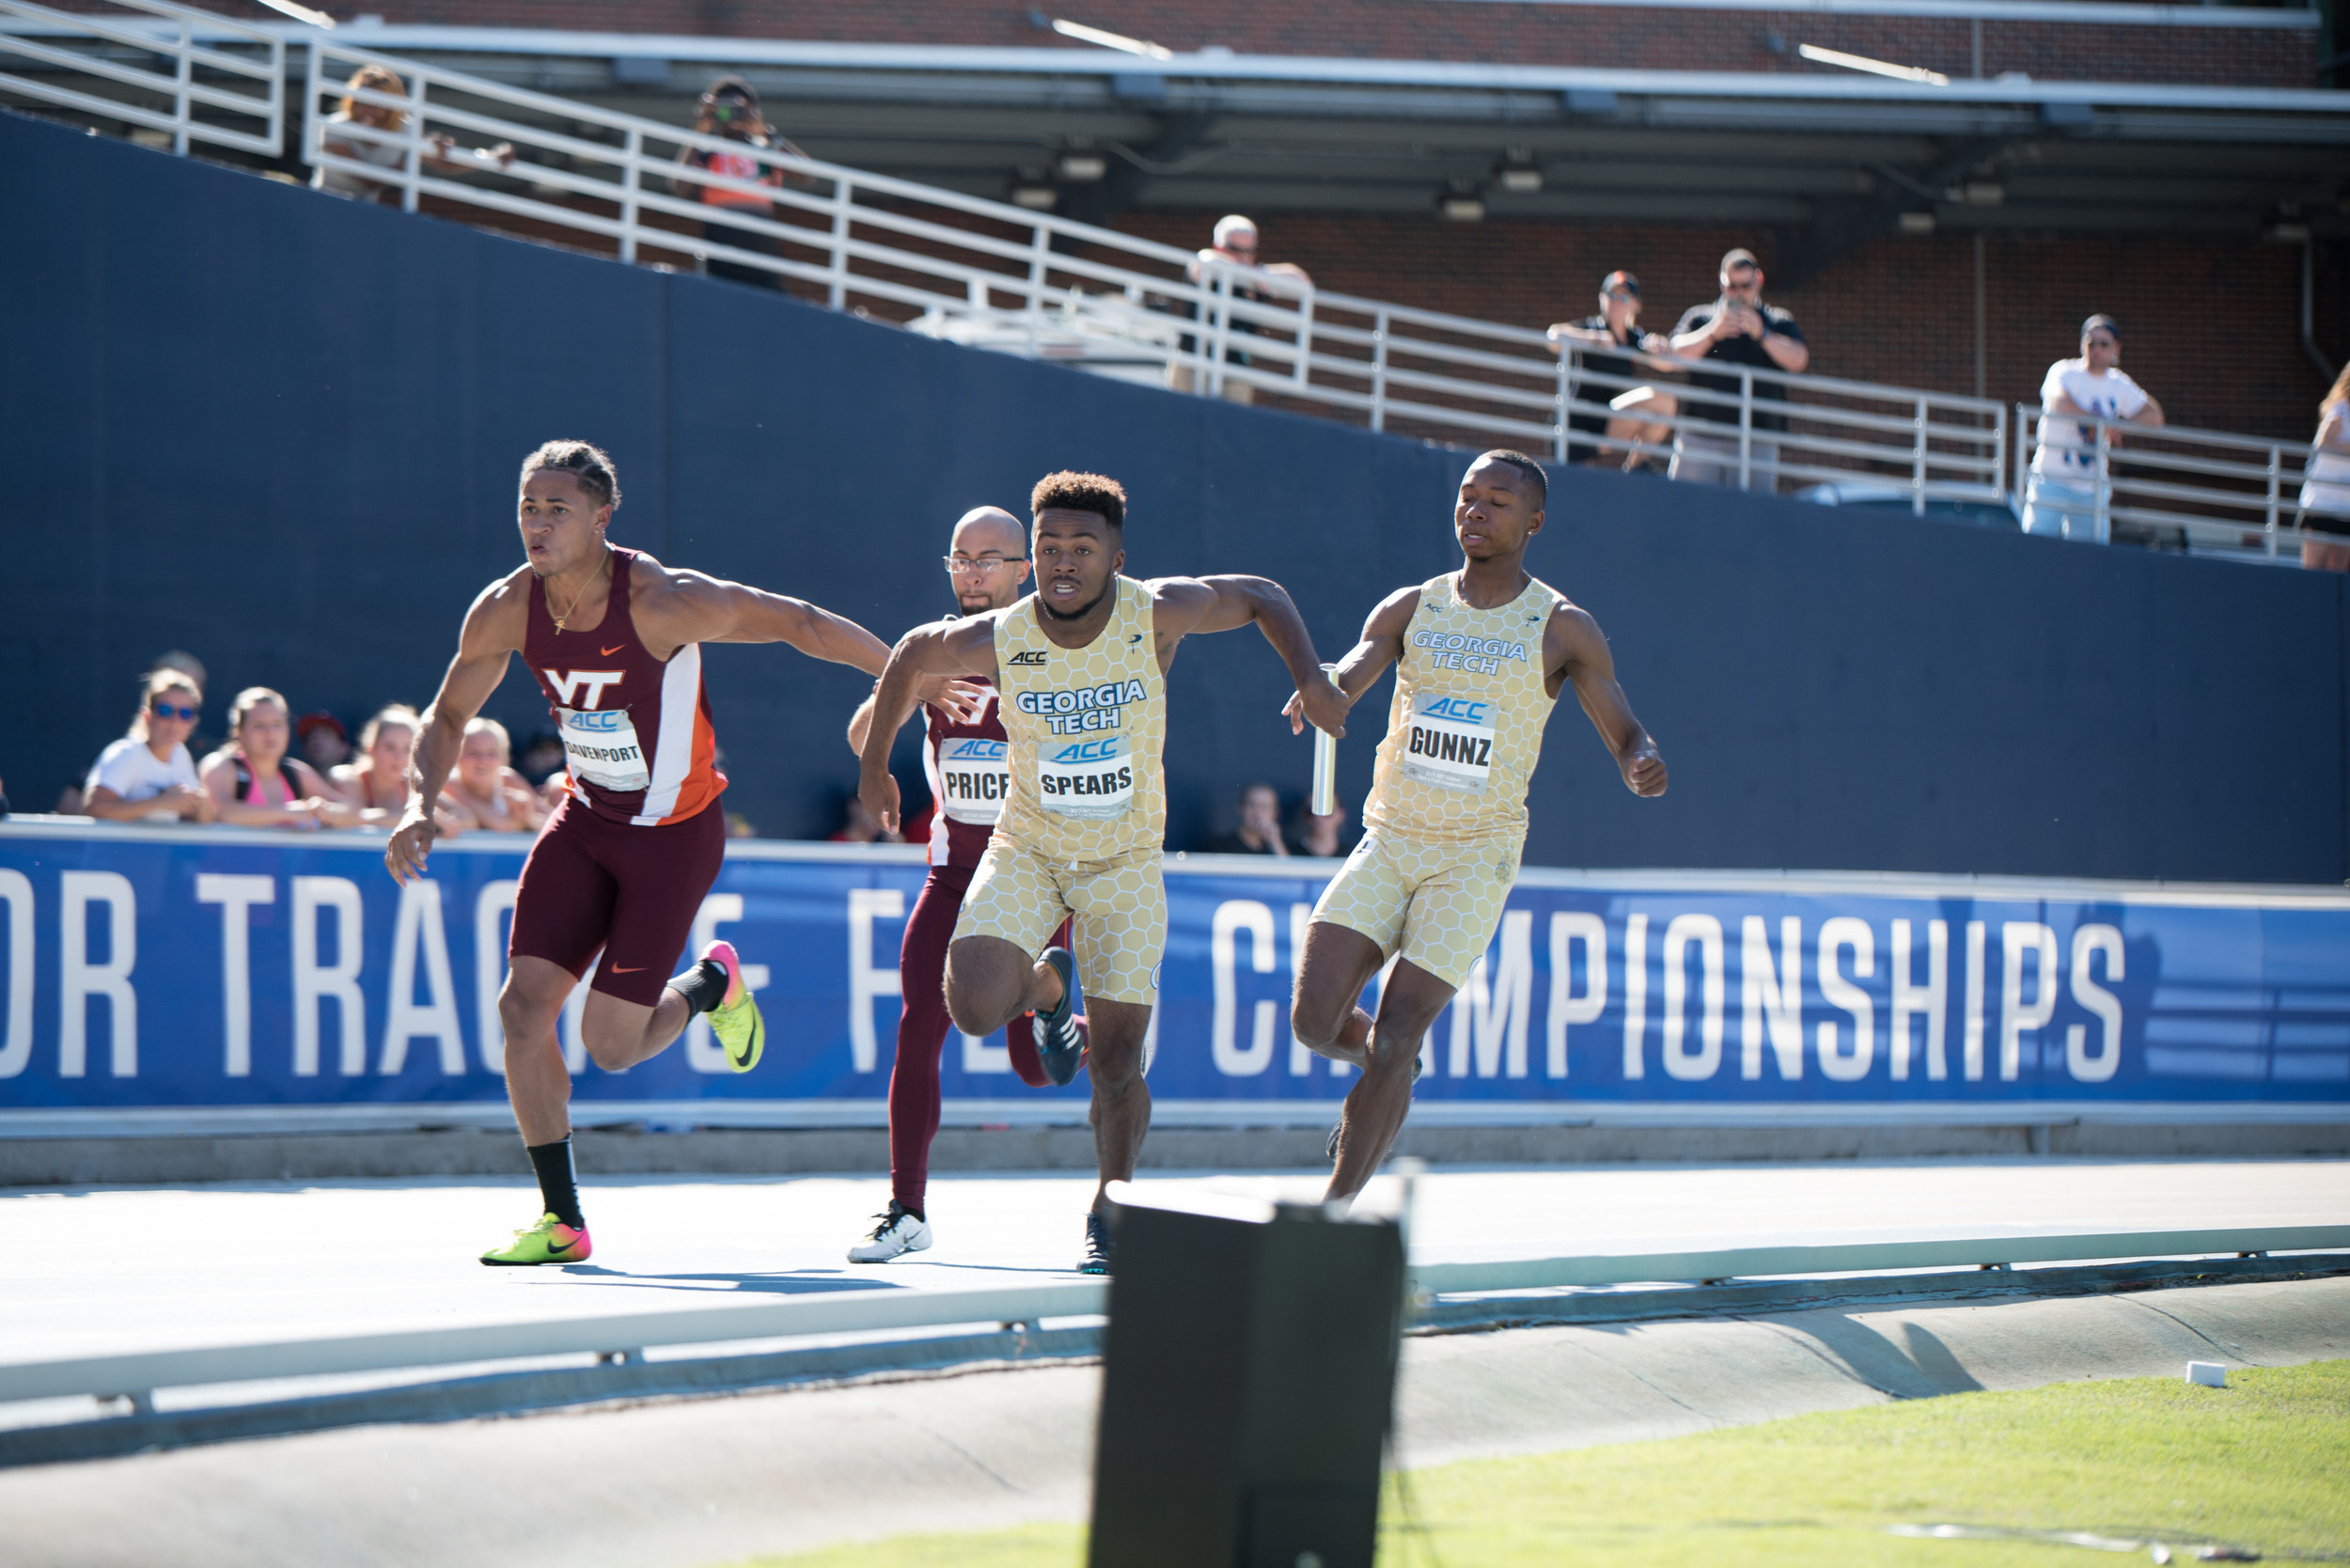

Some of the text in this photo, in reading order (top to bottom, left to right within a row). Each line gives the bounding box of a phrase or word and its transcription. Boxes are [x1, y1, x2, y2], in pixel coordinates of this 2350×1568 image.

[1425, 603, 1444, 613] ACC
[1007, 651, 1048, 666] ACC
[1412, 630, 1528, 662] GEORGIA
[1432, 651, 1500, 676] TECH
[541, 668, 627, 711] VT
[1017, 679, 1147, 714] GEORGIA
[569, 712, 619, 731] ACC
[1045, 707, 1121, 734] TECH
[1421, 698, 1489, 724] ACC
[565, 741, 639, 762] DAVENPORT
[949, 741, 1009, 760] ACC
[1050, 737, 1120, 763] ACC
[1408, 726, 1492, 767] GUNNZ
[1041, 766, 1132, 794] SPEARS
[196, 872, 629, 1077] TRAC
[1212, 898, 2125, 1083] CMPIONSHIPS
